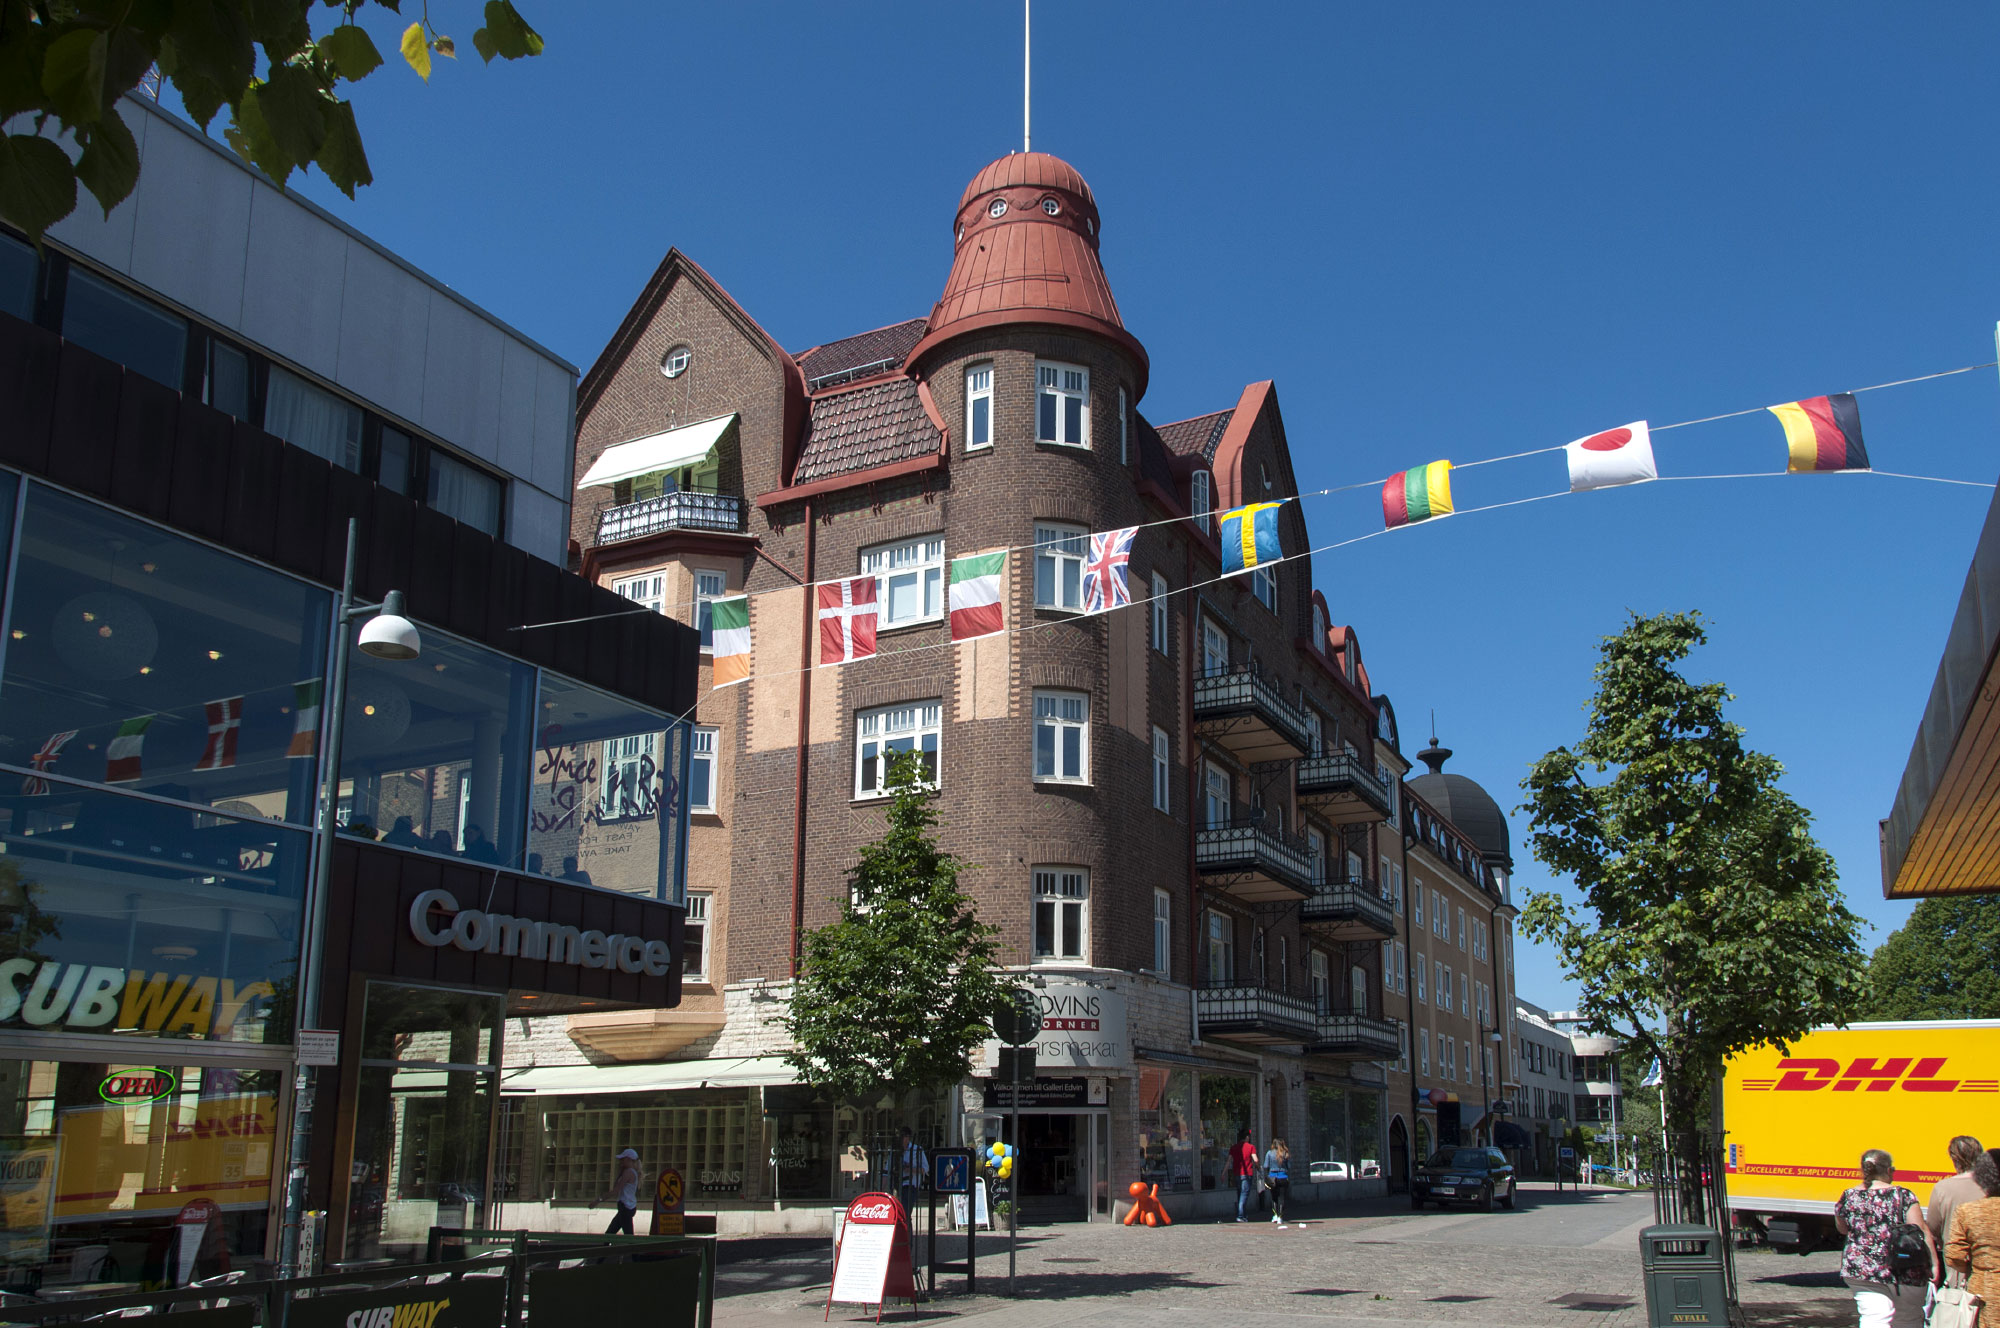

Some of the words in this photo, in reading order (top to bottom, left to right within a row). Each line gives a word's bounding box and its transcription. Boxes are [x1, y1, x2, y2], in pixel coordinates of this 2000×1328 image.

[410, 888, 671, 977] Commerce
[0, 958, 276, 1036] SUBWAY
[1037, 995, 1100, 1017] DVINS
[1042, 1019, 1097, 1030] ORNER
[1001, 1040, 1118, 1058] arsmakat
[1773, 1057, 1961, 1092] DHL
[109, 1076, 164, 1095] OPEN
[0, 1160, 25, 1180] YOU
[225, 1166, 241, 1178] 35
[701, 1170, 741, 1185] EDVINS
[1746, 1165, 1795, 1175] EXCELLENCE.
[1797, 1167, 1826, 1177] SIMPLY
[346, 1296, 451, 1328] SUBWAY
[1673, 1314, 1709, 1322] AVFALL
